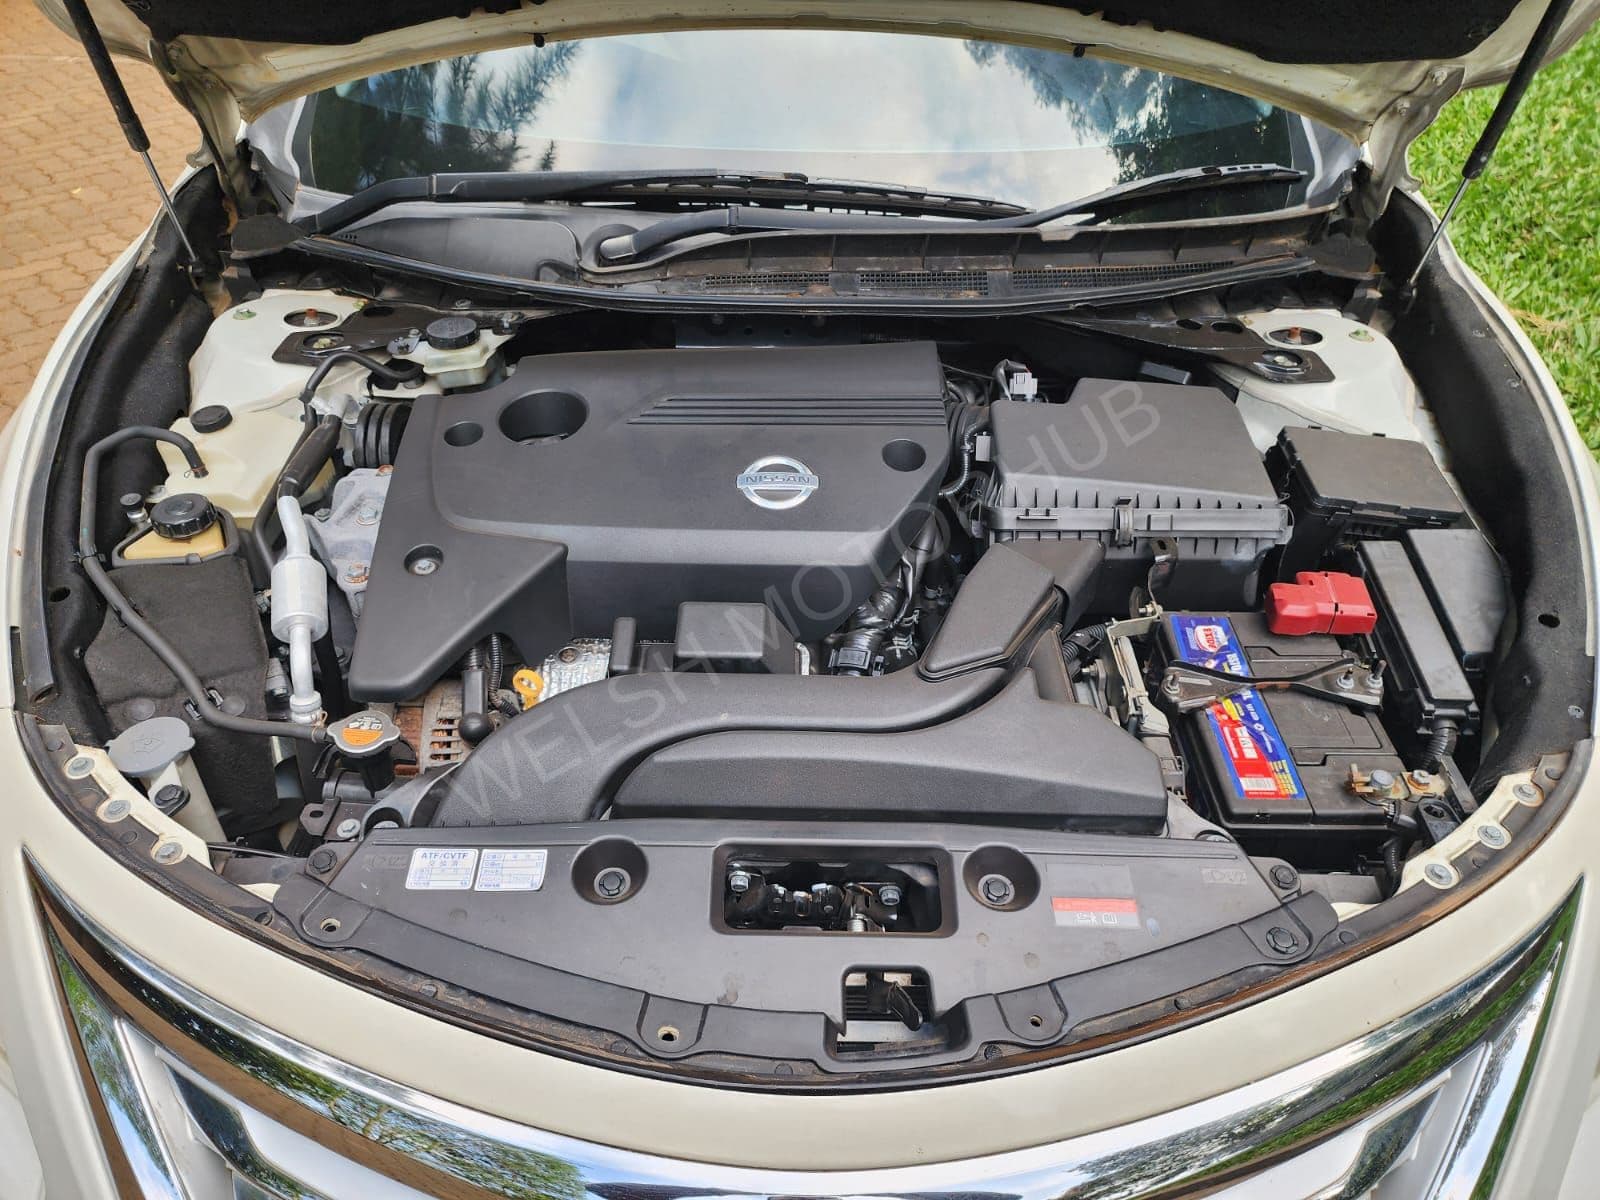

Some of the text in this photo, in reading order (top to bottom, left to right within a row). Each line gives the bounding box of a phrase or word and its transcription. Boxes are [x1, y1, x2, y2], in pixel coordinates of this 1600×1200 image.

[745, 475, 810, 484] NISSAN
[1202, 627, 1217, 649] EXIDE
[421, 852, 469, 860] ATF/CVTF
